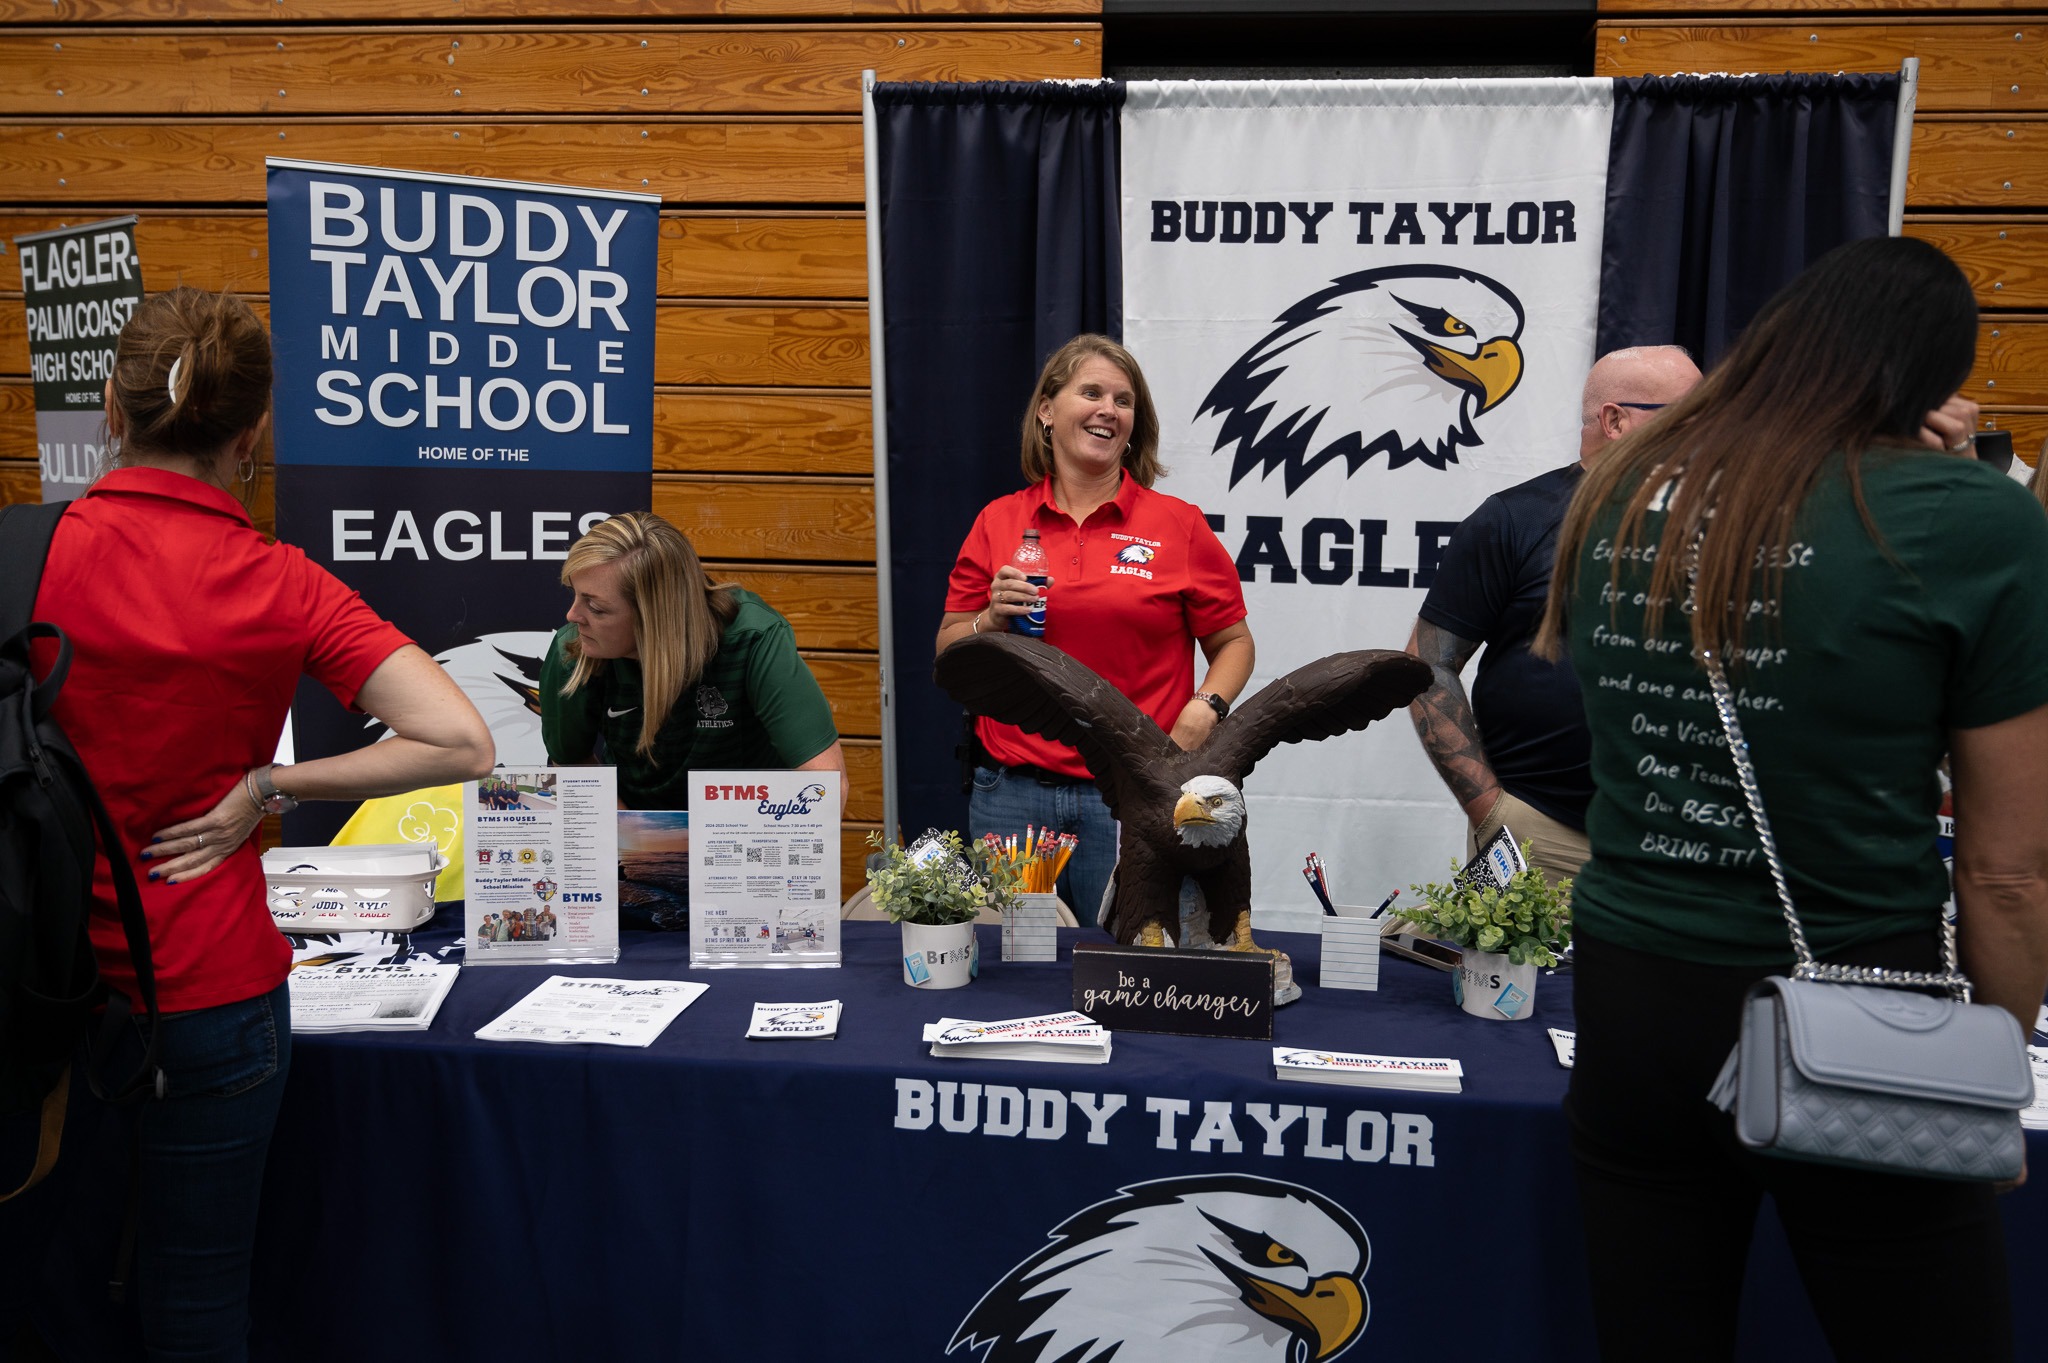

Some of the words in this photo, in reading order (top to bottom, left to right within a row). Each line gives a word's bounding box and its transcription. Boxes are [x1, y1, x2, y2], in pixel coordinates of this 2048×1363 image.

[310, 180, 628, 266] BUDDY
[1150, 200, 1334, 244] BUDDY
[1348, 200, 1576, 245] TAYLOR
[20, 231, 139, 293] FLAGLER-
[310, 249, 630, 332] TAYLOR
[27, 304, 74, 342] PALM
[75, 297, 138, 339] COAST
[321, 325, 624, 374] MIDDLE
[31, 352, 67, 383] HIGH
[314, 370, 630, 434] SCHOOL
[418, 446, 468, 460] HOME
[472, 448, 494, 460] OF
[498, 448, 530, 462] THE
[1111, 533, 1134, 542] BUDDY
[1135, 537, 1162, 547] TAYLOR
[1203, 514, 1461, 589] AGLE
[1110, 566, 1153, 580] EAGLES
[1600, 582, 1626, 606] for
[1592, 625, 1636, 648] from
[1644, 638, 1683, 654] our
[1598, 674, 1633, 692] and
[1637, 681, 1675, 699] one
[1682, 688, 1784, 711] anher.
[696, 720, 734, 728] ATHLETICS
[1632, 713, 1668, 738] One
[1678, 720, 1728, 746] Visio
[1637, 755, 1680, 779] One
[705, 785, 769, 800] BTMS
[758, 799, 811, 821] Eagles
[1494, 848, 1511, 879] BTMS
[1640, 832, 1710, 864] BRING
[1718, 848, 1757, 867] IT!
[563, 893, 602, 902] BTMS
[926, 945, 970, 965] BTMS
[1119, 971, 1135, 988] be
[1143, 978, 1150, 988] a
[1084, 988, 1149, 1012] game
[1154, 985, 1260, 1020] changer
[984, 1021, 1027, 1032] BUDDY
[1028, 1014, 1081, 1025] TAYLOR
[1049, 1018, 1085, 1026] EAGLES
[894, 1078, 1127, 1145] BUDDY
[1146, 1096, 1436, 1168] TAYLOR
